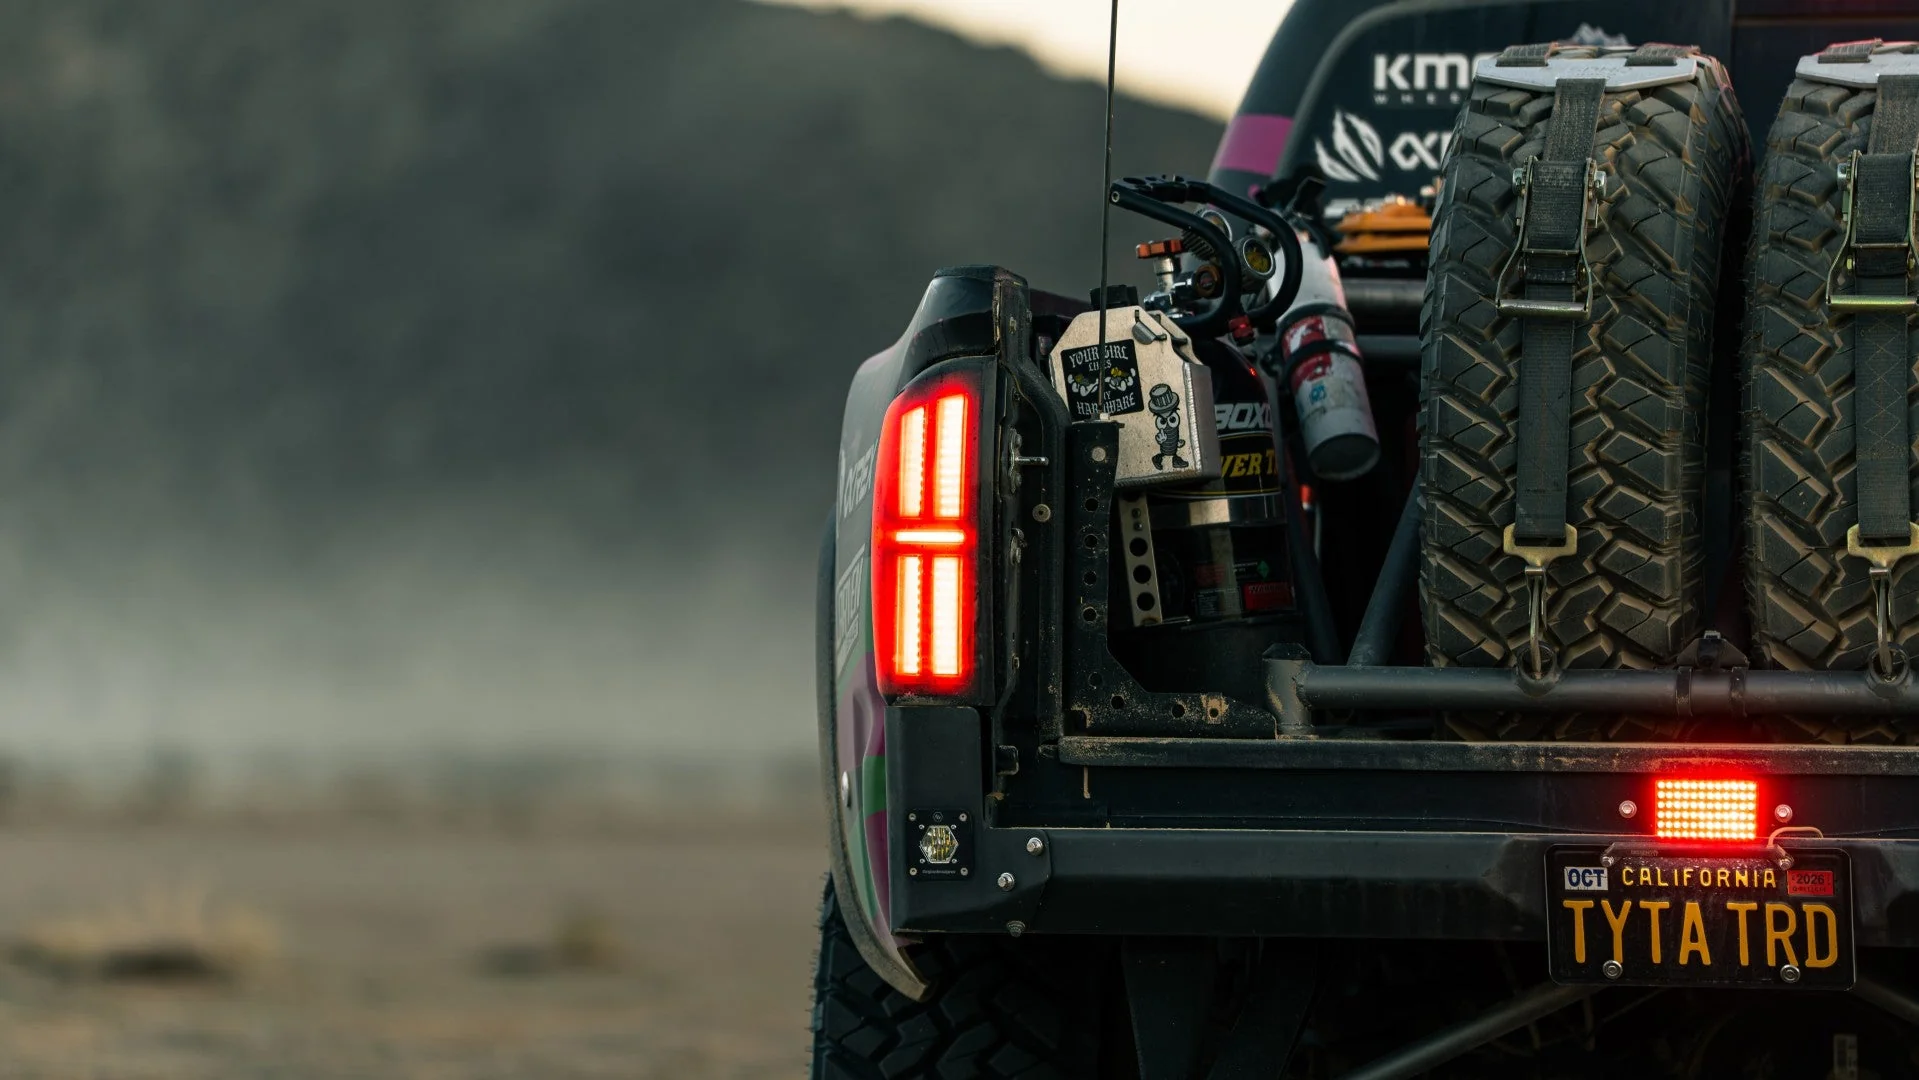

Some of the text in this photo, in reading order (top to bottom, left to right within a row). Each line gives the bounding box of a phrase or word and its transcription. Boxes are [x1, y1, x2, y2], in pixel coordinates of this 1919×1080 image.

[1069, 346, 1100, 368] YOUR
[1568, 867, 1825, 888] OCT CALIFORNIA 2026
[1562, 900, 1838, 968] TYTA TRD
